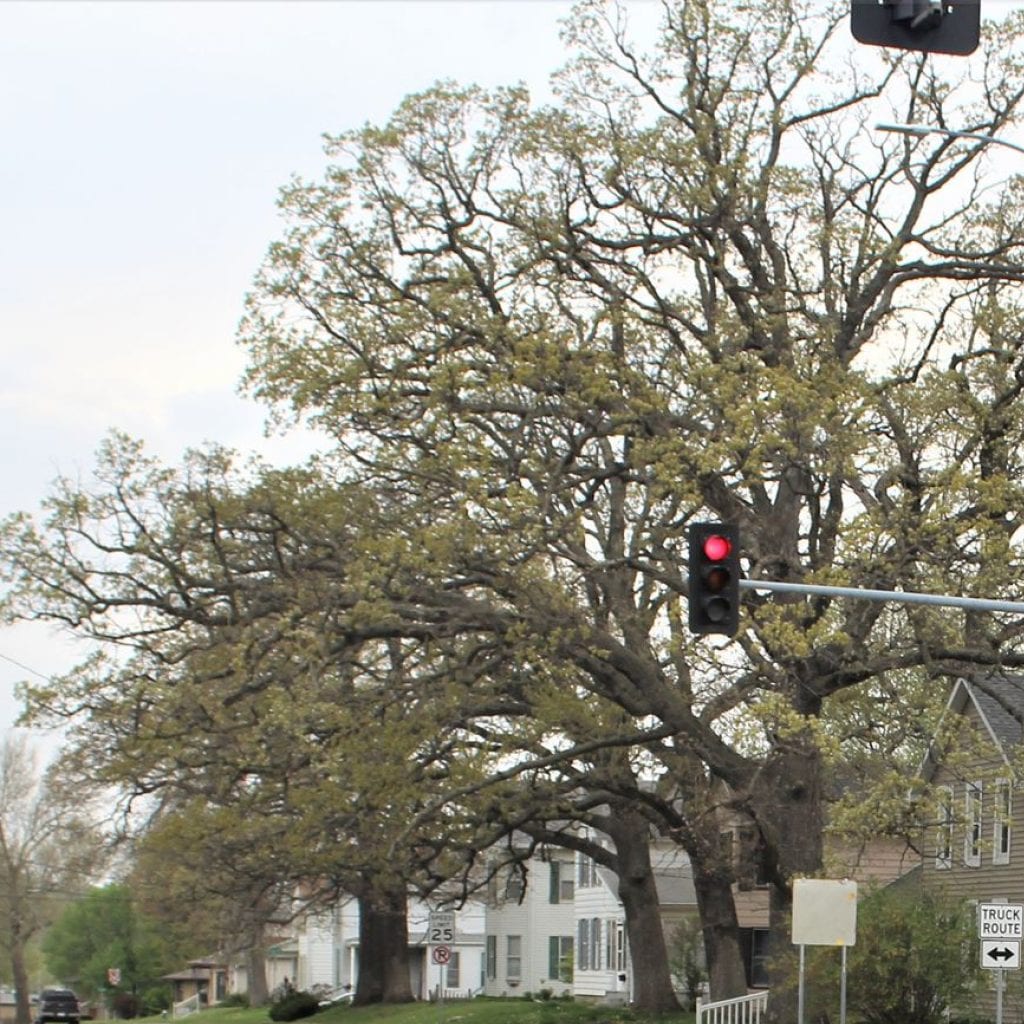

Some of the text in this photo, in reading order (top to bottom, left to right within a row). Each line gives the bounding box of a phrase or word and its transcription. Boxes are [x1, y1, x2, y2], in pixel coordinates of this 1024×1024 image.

[982, 909, 1021, 920] TRUCK
[983, 923, 1021, 934] ROUTE
[431, 928, 453, 941] 25
